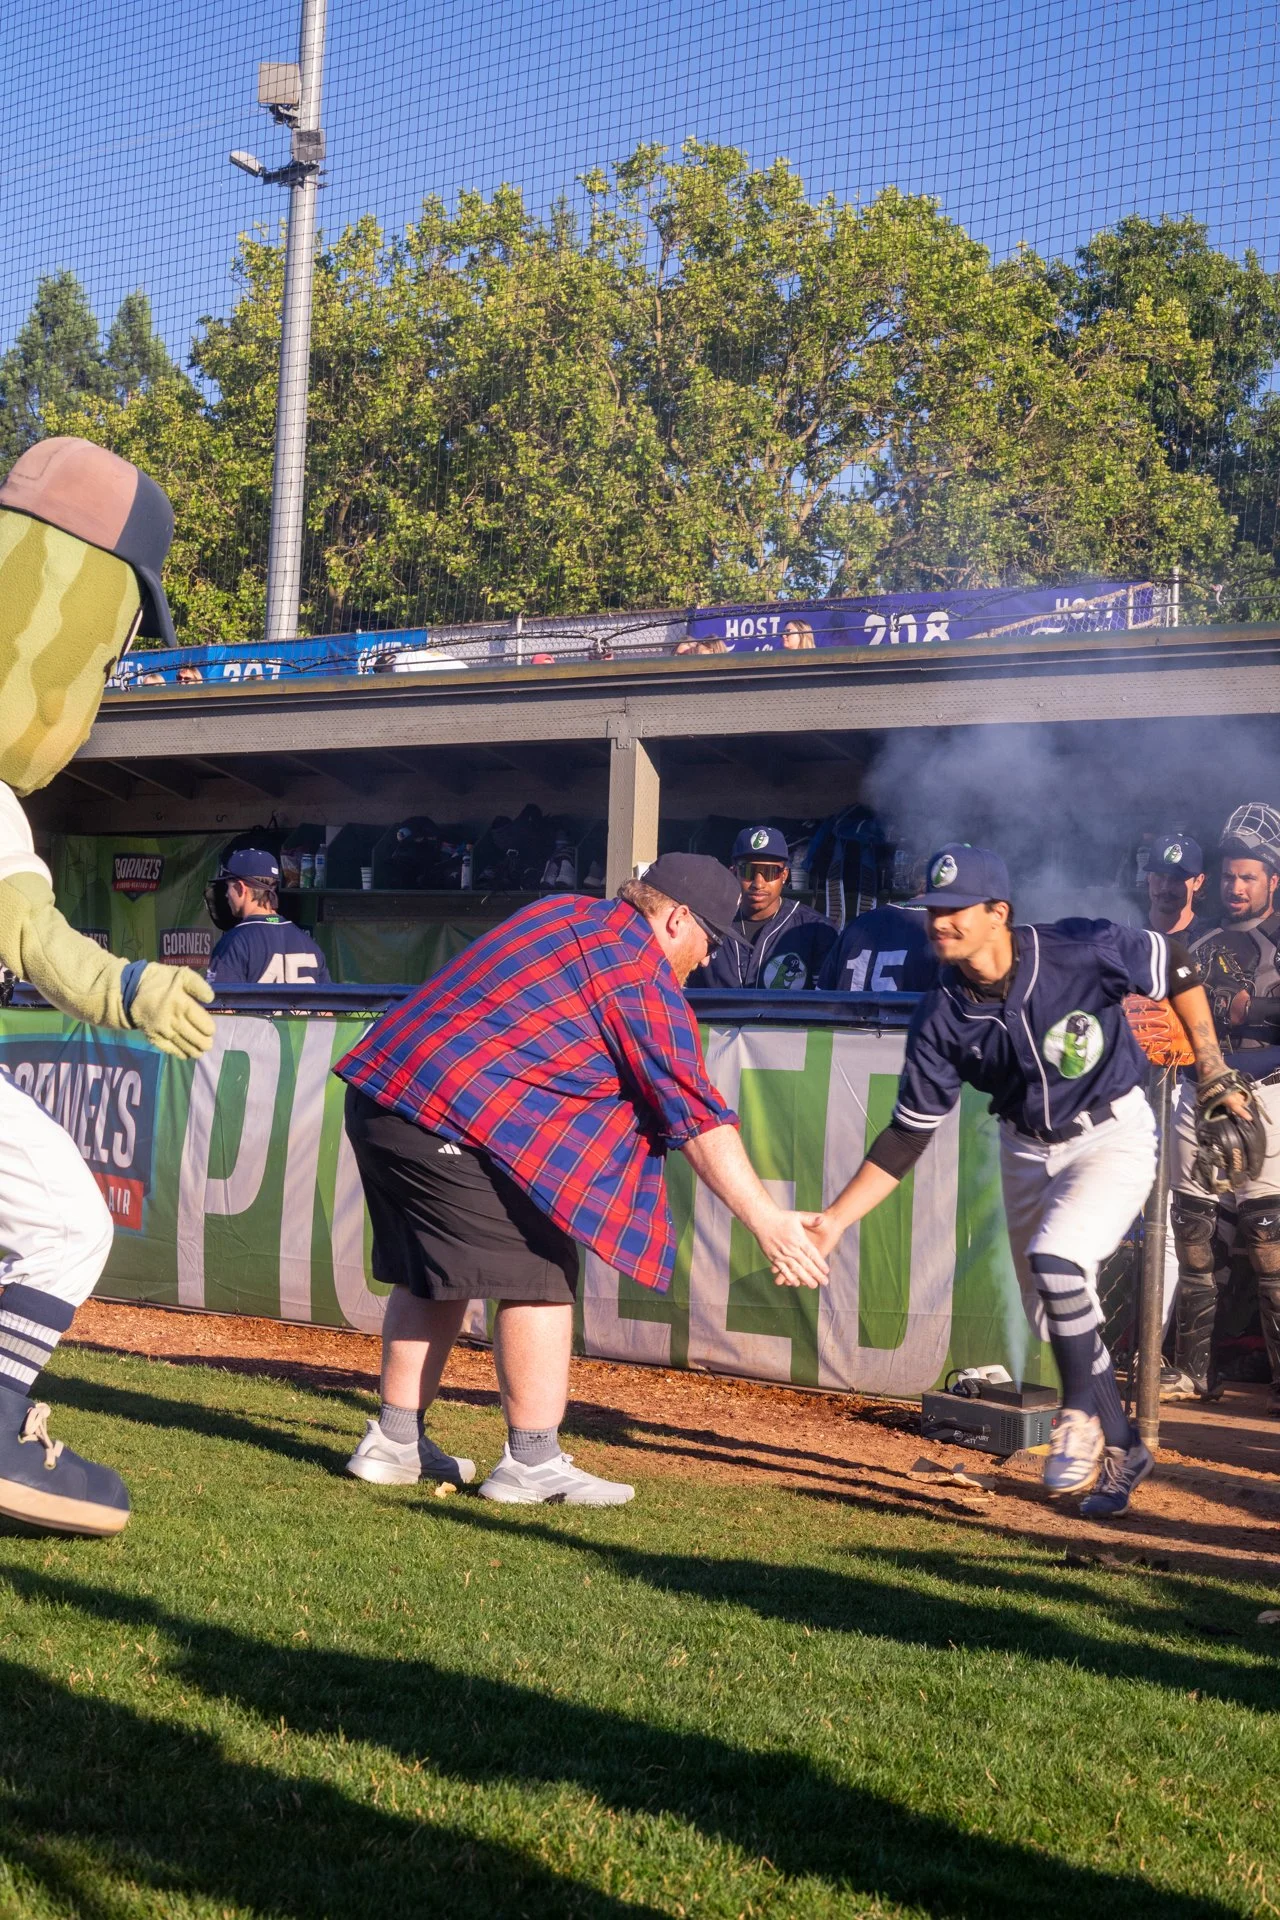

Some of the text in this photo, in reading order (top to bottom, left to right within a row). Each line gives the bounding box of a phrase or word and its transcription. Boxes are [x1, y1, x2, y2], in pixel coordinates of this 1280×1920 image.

[725, 616, 781, 641] HOST
[864, 611, 950, 646] 208
[115, 858, 161, 880] CORNEL'S
[163, 932, 210, 956] CORNEL'S
[846, 949, 907, 992] 15
[108, 1186, 130, 1216] AIR
[177, 1015, 960, 1396] PIED
